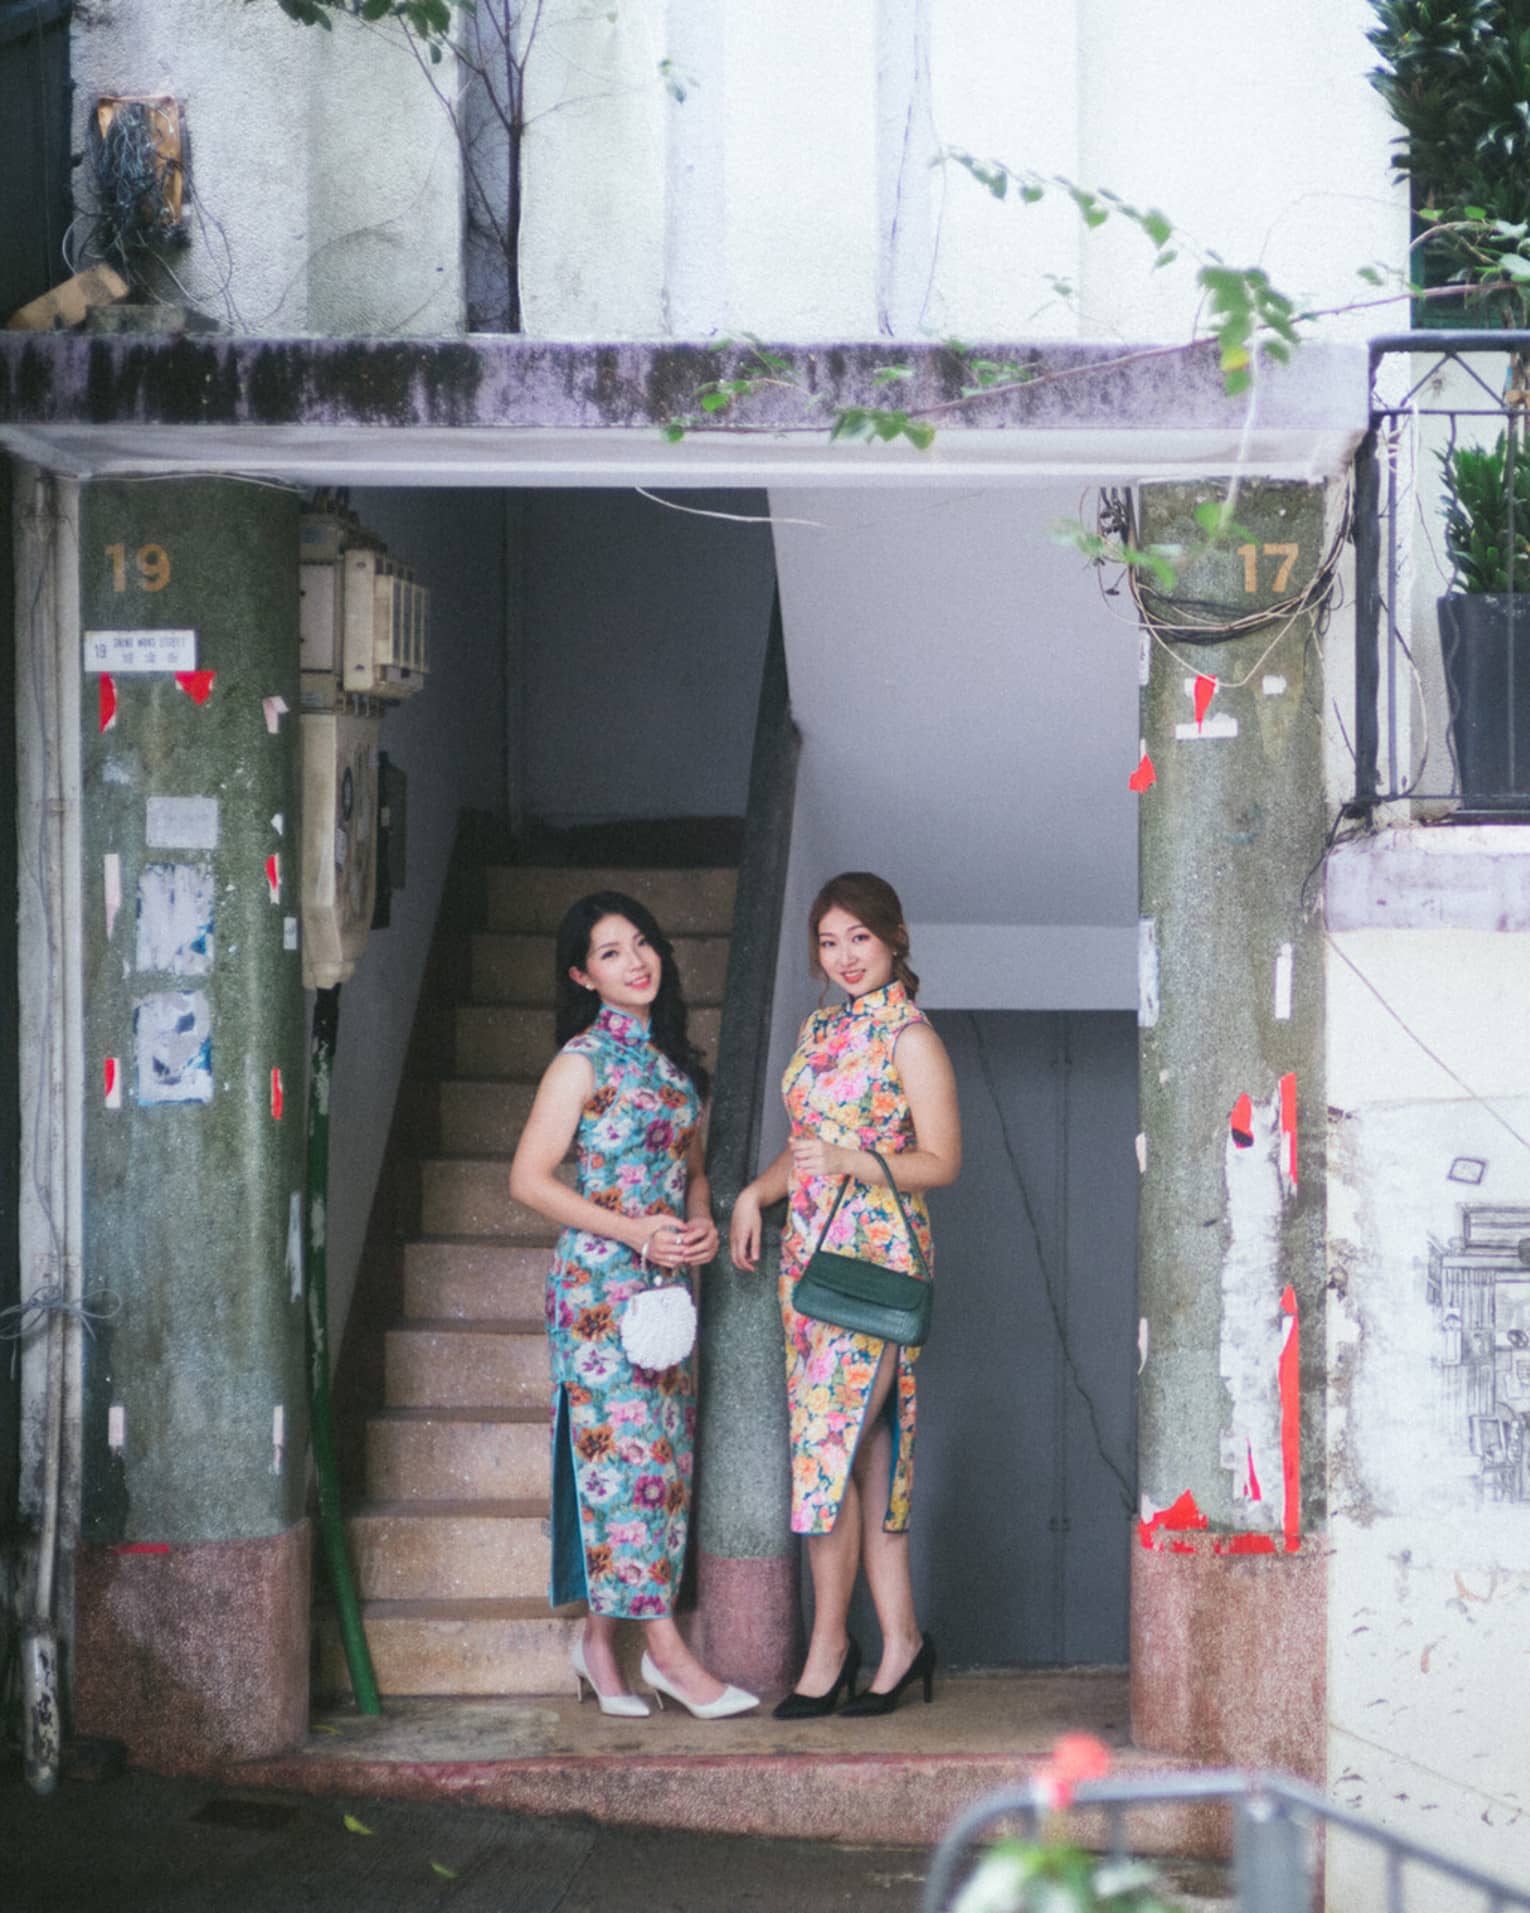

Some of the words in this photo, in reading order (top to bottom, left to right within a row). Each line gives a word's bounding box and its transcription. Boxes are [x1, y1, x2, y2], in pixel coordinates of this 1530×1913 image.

[105, 544, 171, 592] 19
[1237, 544, 1298, 592] 17
[95, 643, 107, 659] 19
